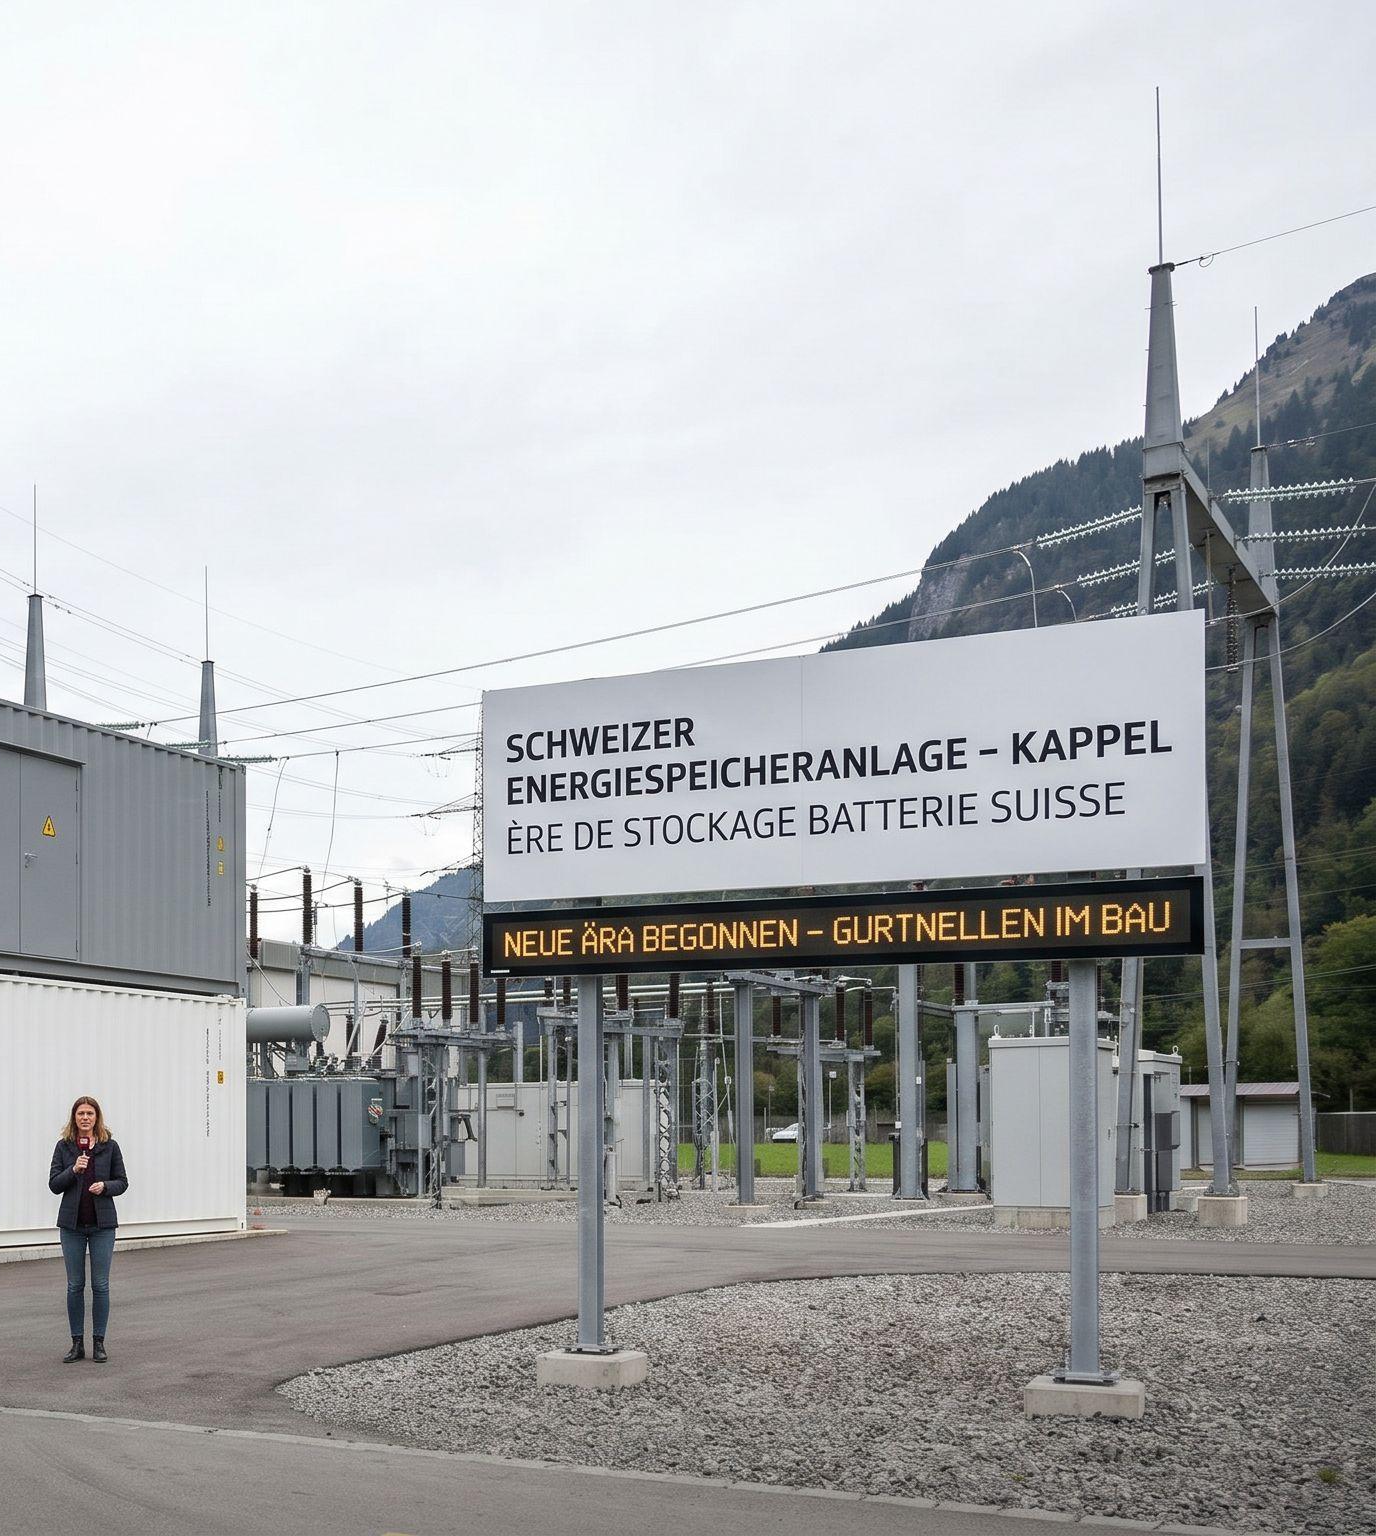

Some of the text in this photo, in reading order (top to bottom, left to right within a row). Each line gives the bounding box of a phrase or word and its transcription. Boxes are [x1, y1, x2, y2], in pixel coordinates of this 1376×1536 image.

[506, 717, 696, 763] SCHWEIZER
[507, 737, 968, 806] ENERGIESPEICHERANLAGE
[1012, 719, 1173, 765] KAPPEL
[507, 781, 1126, 855] ÈRE DE STOCKAGE BATTERIE SUISSE
[504, 928, 574, 958] NEUE
[581, 921, 634, 955] ÄRA
[642, 918, 799, 953] BEGONNEN
[834, 908, 1046, 946] GURTNELLEN
[1056, 906, 1091, 938] IM
[1102, 902, 1171, 936] BAU
